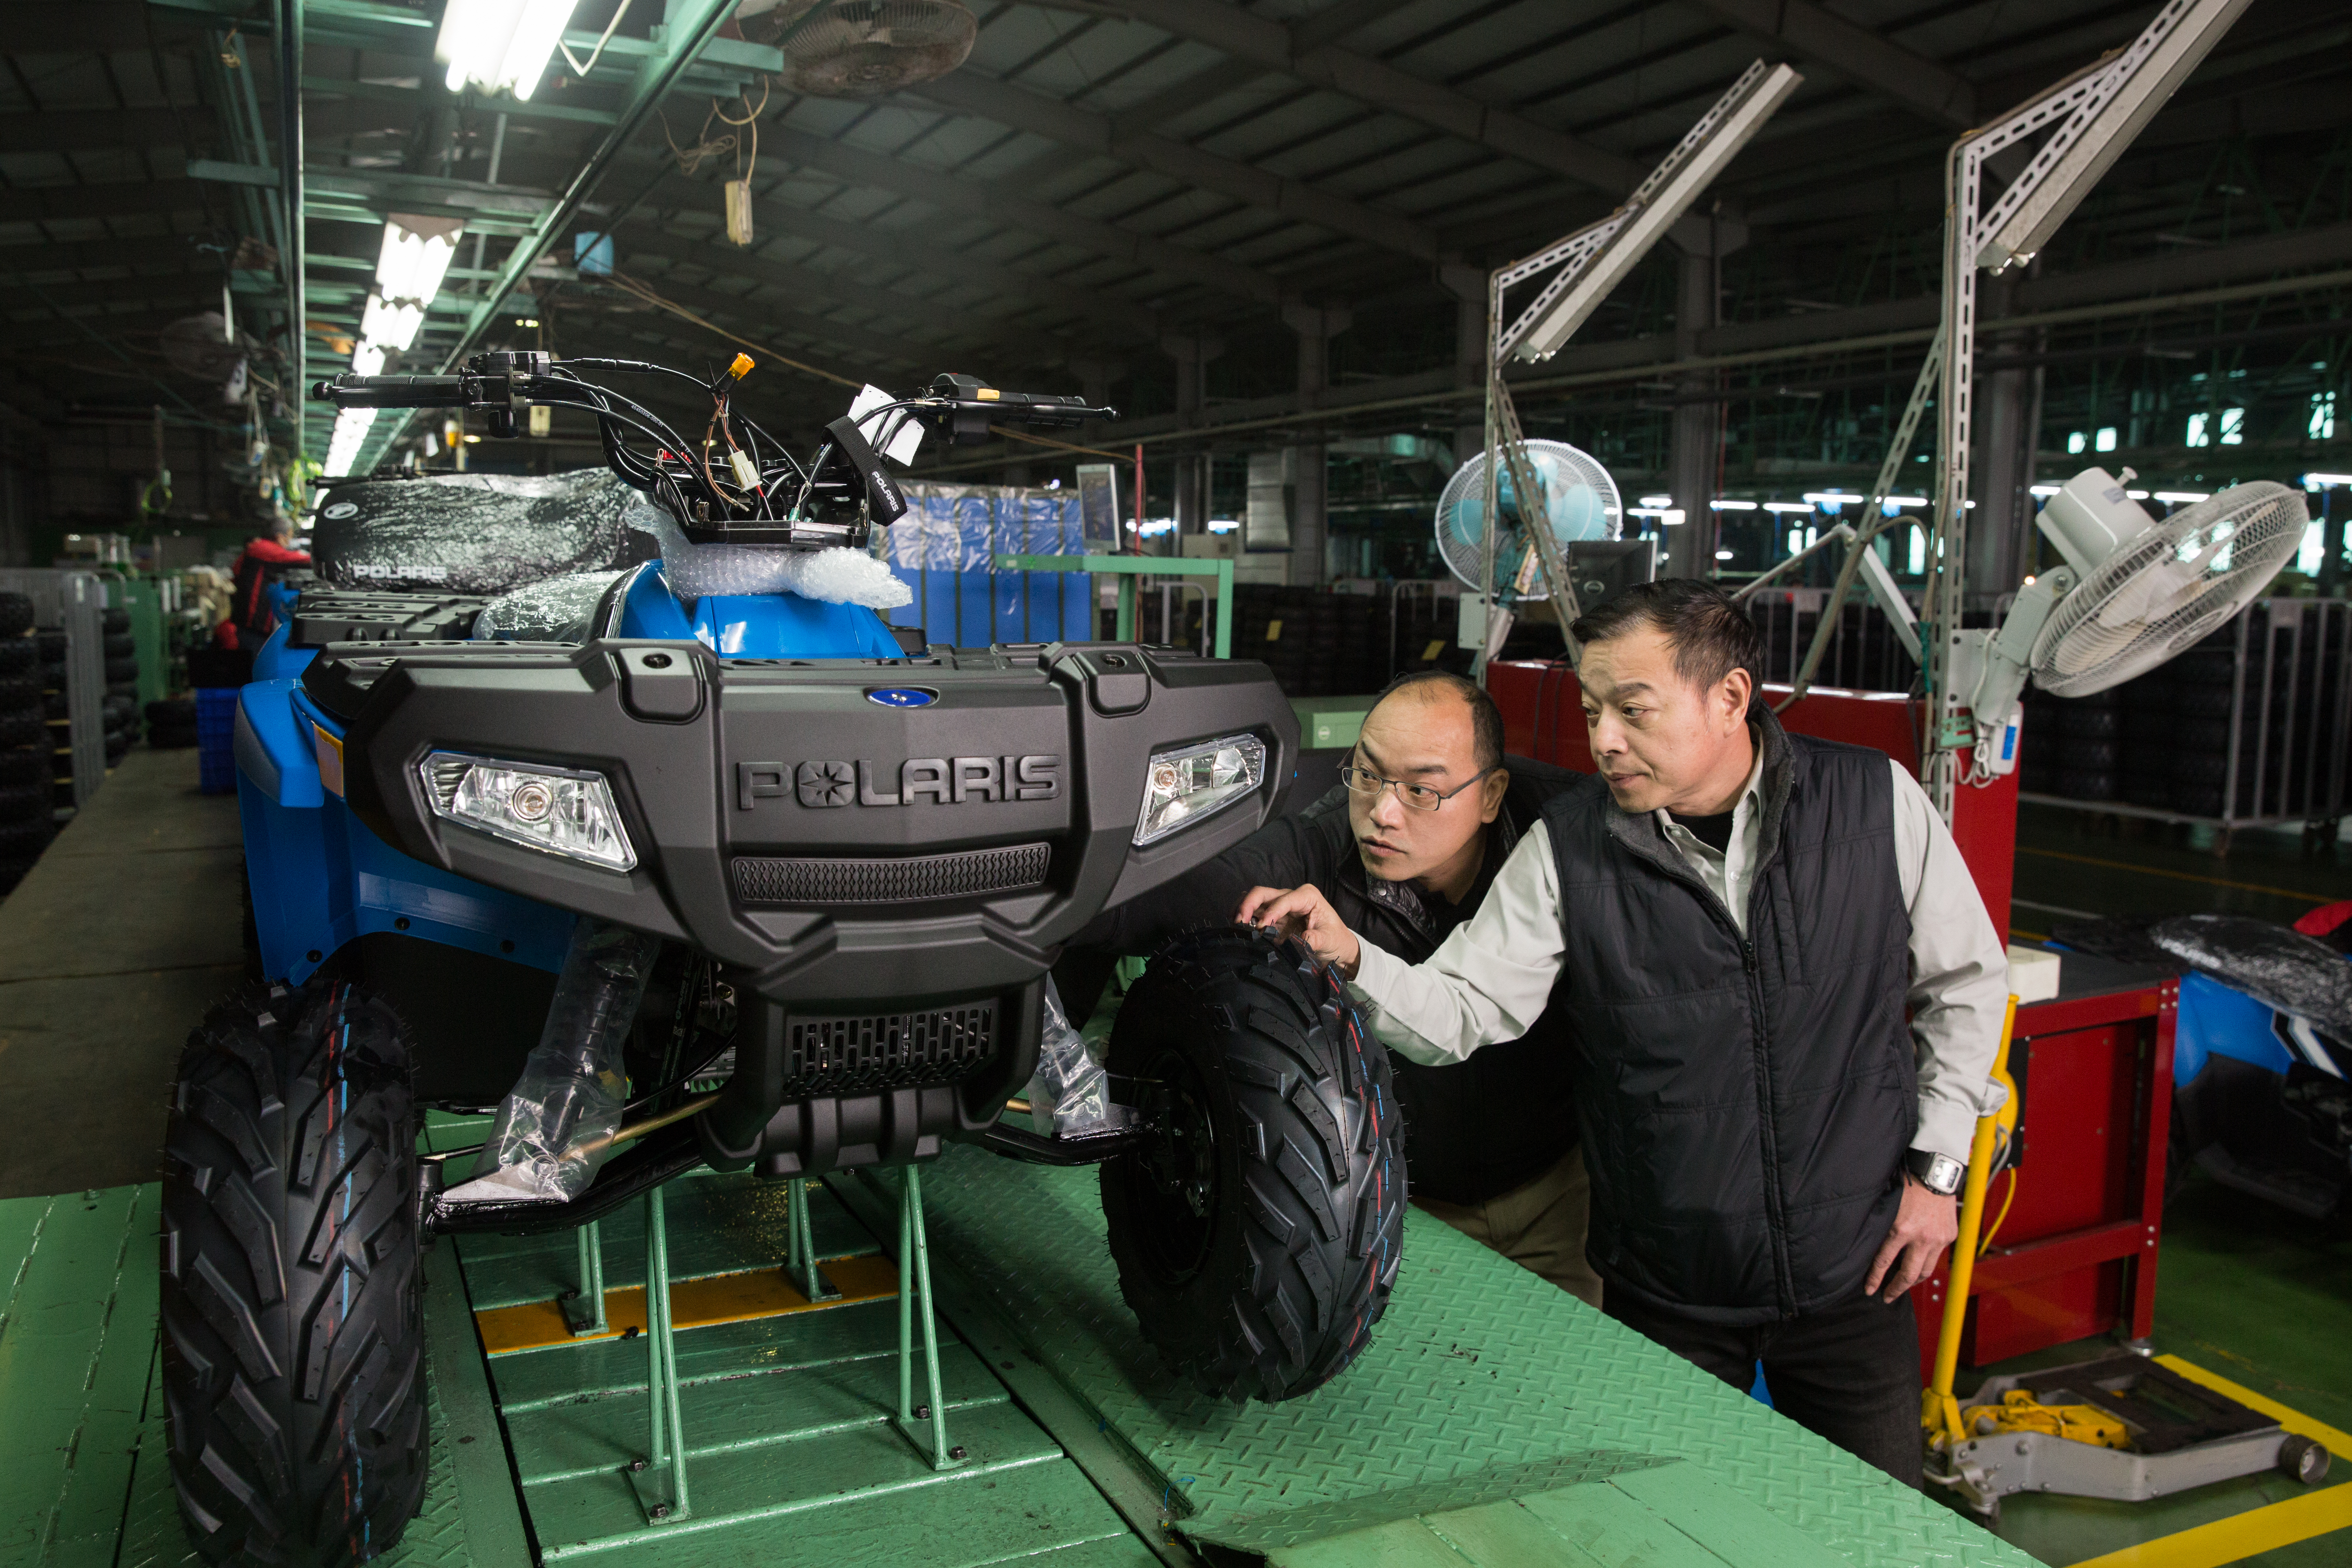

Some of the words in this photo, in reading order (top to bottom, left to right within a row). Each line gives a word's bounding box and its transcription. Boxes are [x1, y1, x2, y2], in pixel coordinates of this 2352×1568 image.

[631, 405, 664, 428] 45450206-000-01
[871, 471, 899, 512] POLARIS
[352, 565, 448, 579] POLARIS
[737, 755, 1062, 809] POLARIS
